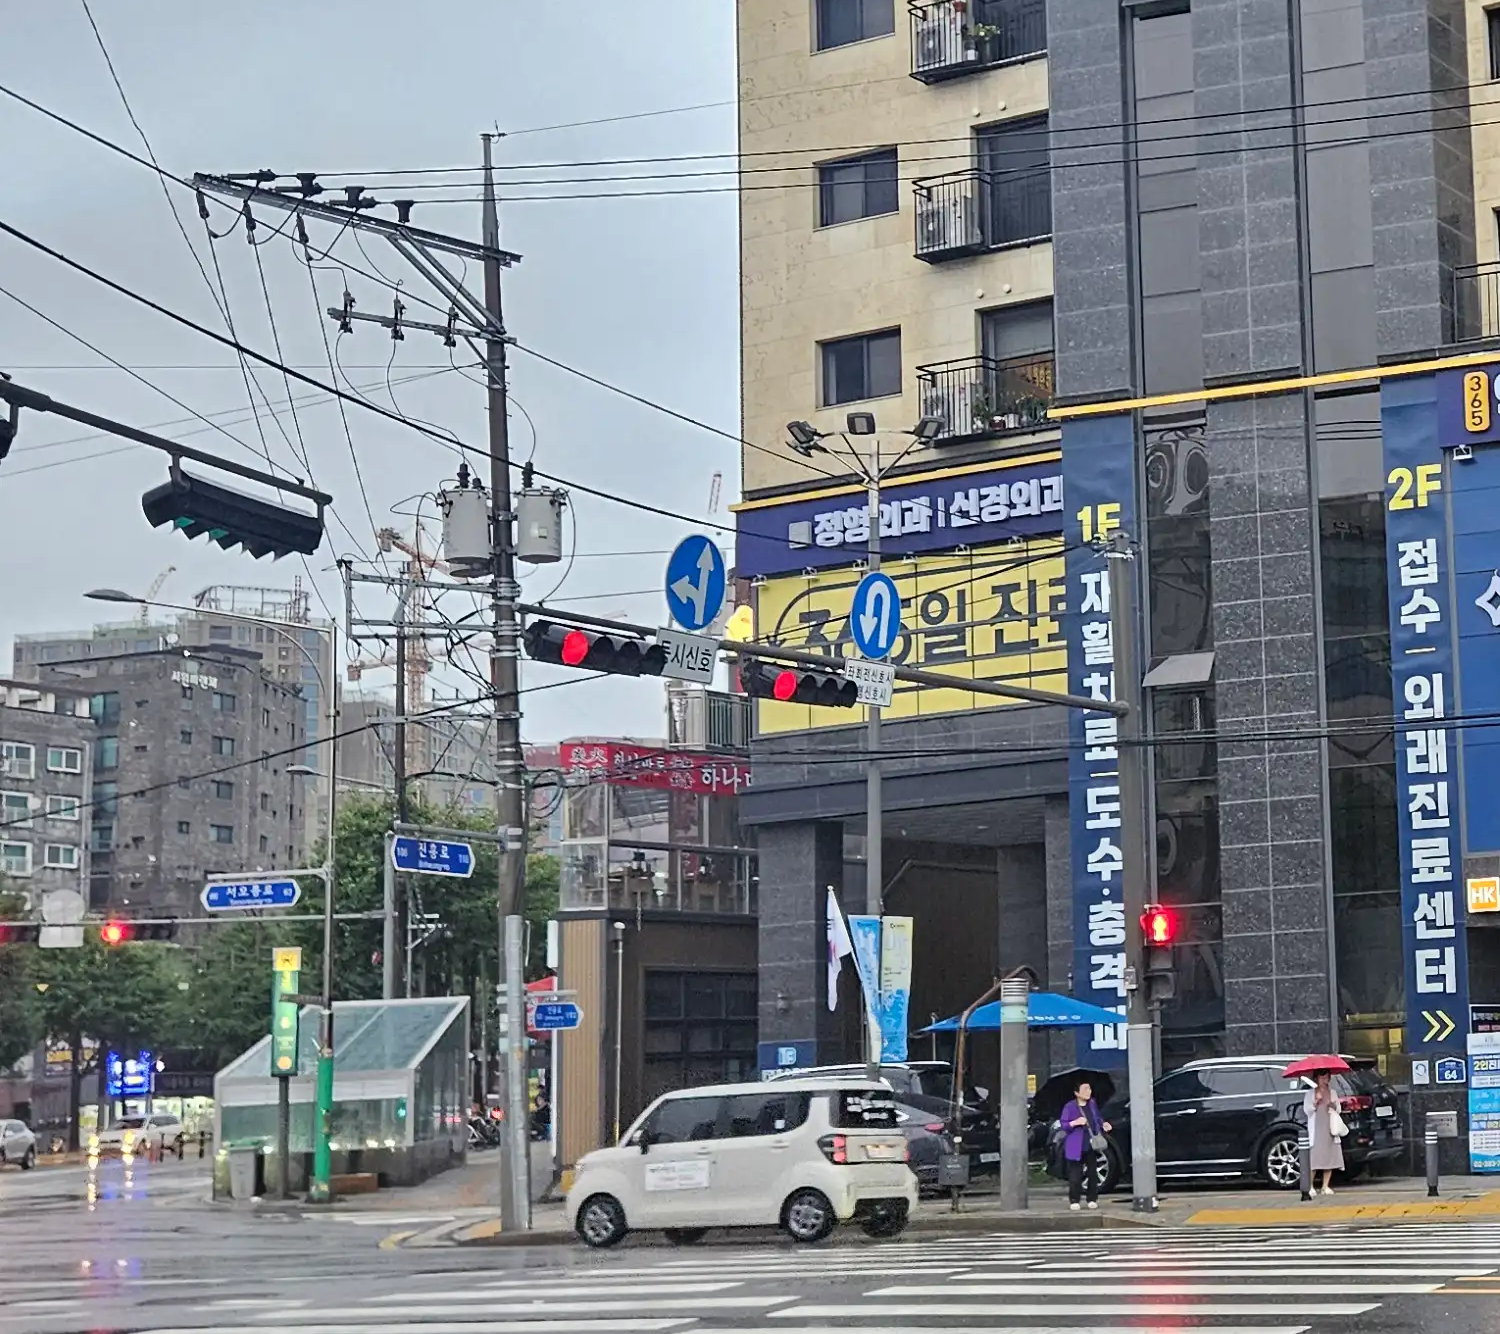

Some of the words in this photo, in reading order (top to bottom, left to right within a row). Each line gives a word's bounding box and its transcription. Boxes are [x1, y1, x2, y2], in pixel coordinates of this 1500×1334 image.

[1469, 375, 1483, 427] 365
[1387, 463, 1442, 511] 2F
[814, 495, 932, 548] 정형외과
[950, 475, 1064, 528] 신경외과
[1077, 502, 1121, 543] 1F
[1471, 886, 1497, 904] HK
[1444, 1069, 1458, 1080] 64
